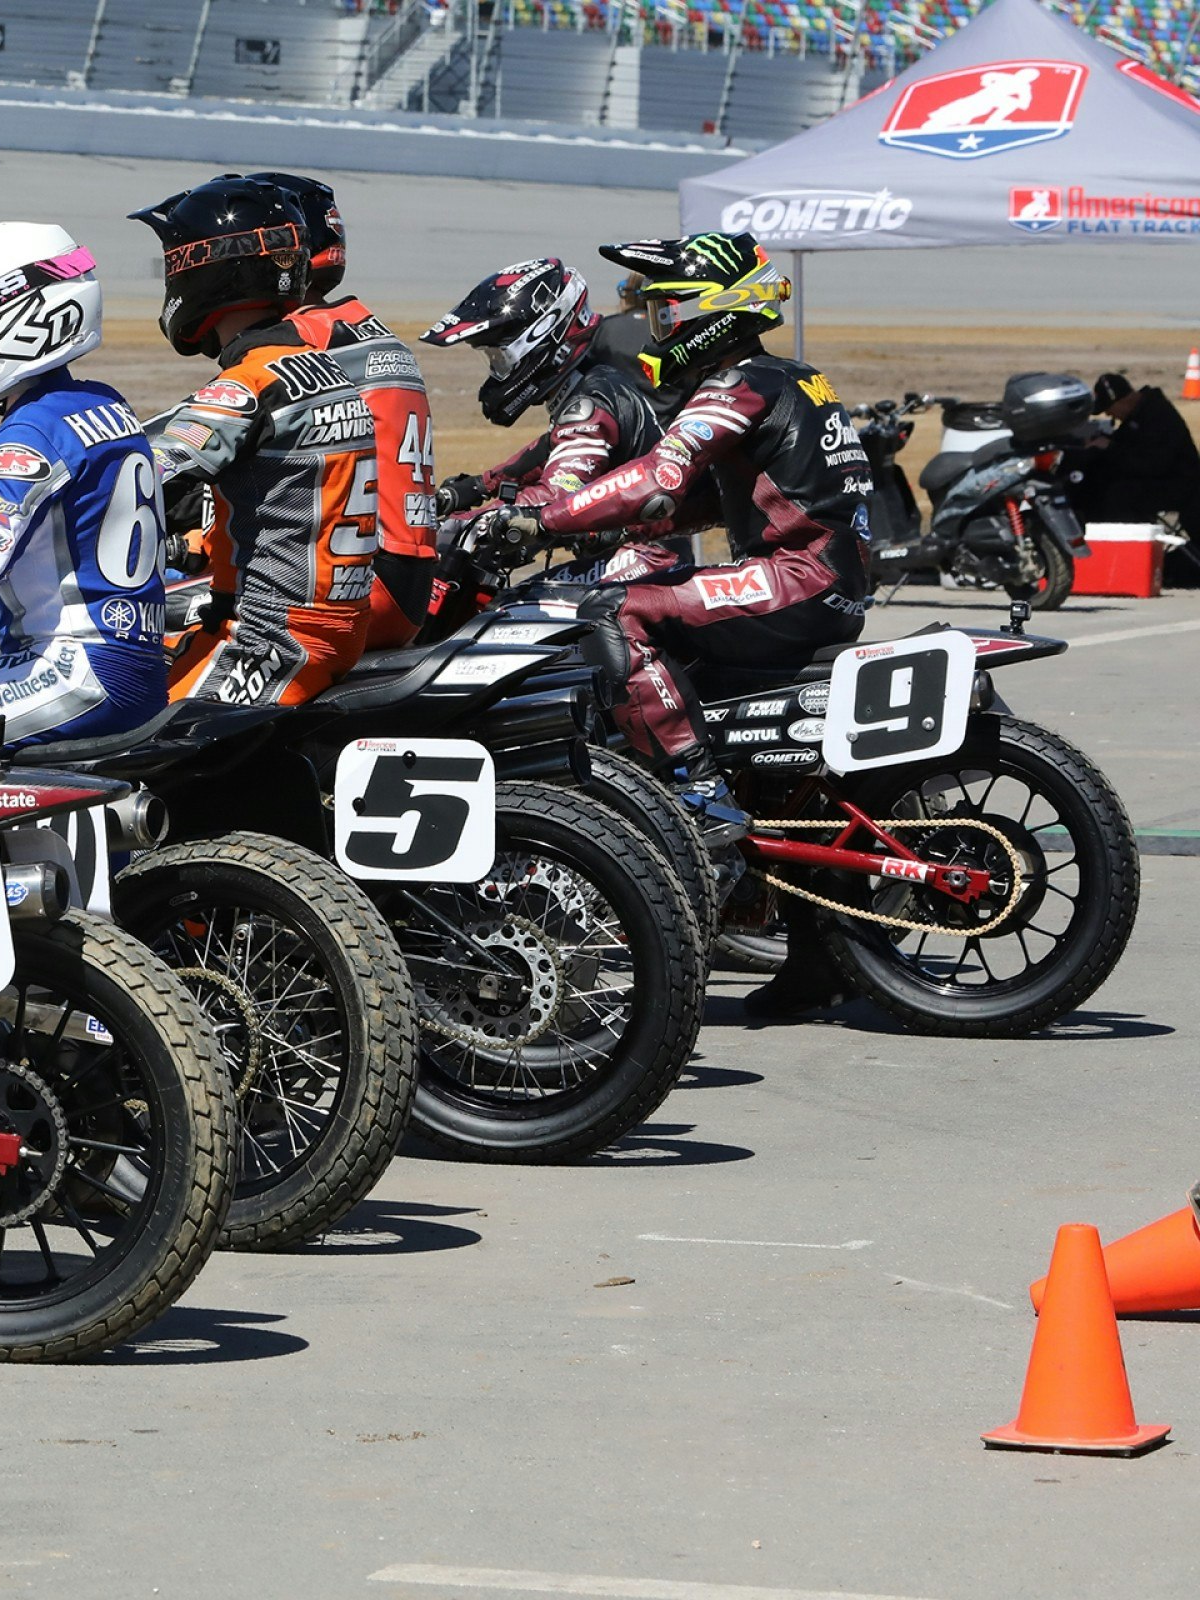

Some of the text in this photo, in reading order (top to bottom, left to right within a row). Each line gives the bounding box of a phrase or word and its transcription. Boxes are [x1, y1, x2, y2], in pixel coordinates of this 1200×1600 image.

[721, 198, 913, 234] COMETIC
[1067, 220, 1121, 233] FLAT
[750, 231, 806, 241] ASKET
[685, 312, 738, 350] MONSTER
[797, 374, 841, 406] ME
[64, 401, 145, 449] HALB
[313, 398, 373, 426] HARLE
[300, 418, 375, 446] DAVIDS
[328, 453, 379, 557] 5
[572, 469, 644, 512] MOTUL
[97, 450, 165, 589] 6
[701, 570, 765, 598] RK
[851, 648, 949, 761] 9
[727, 728, 779, 743] MOTUL
[753, 752, 817, 765] COMETIC
[345, 755, 485, 869] 5
[882, 860, 928, 881] RK
[88, 1018, 106, 1033] EB
